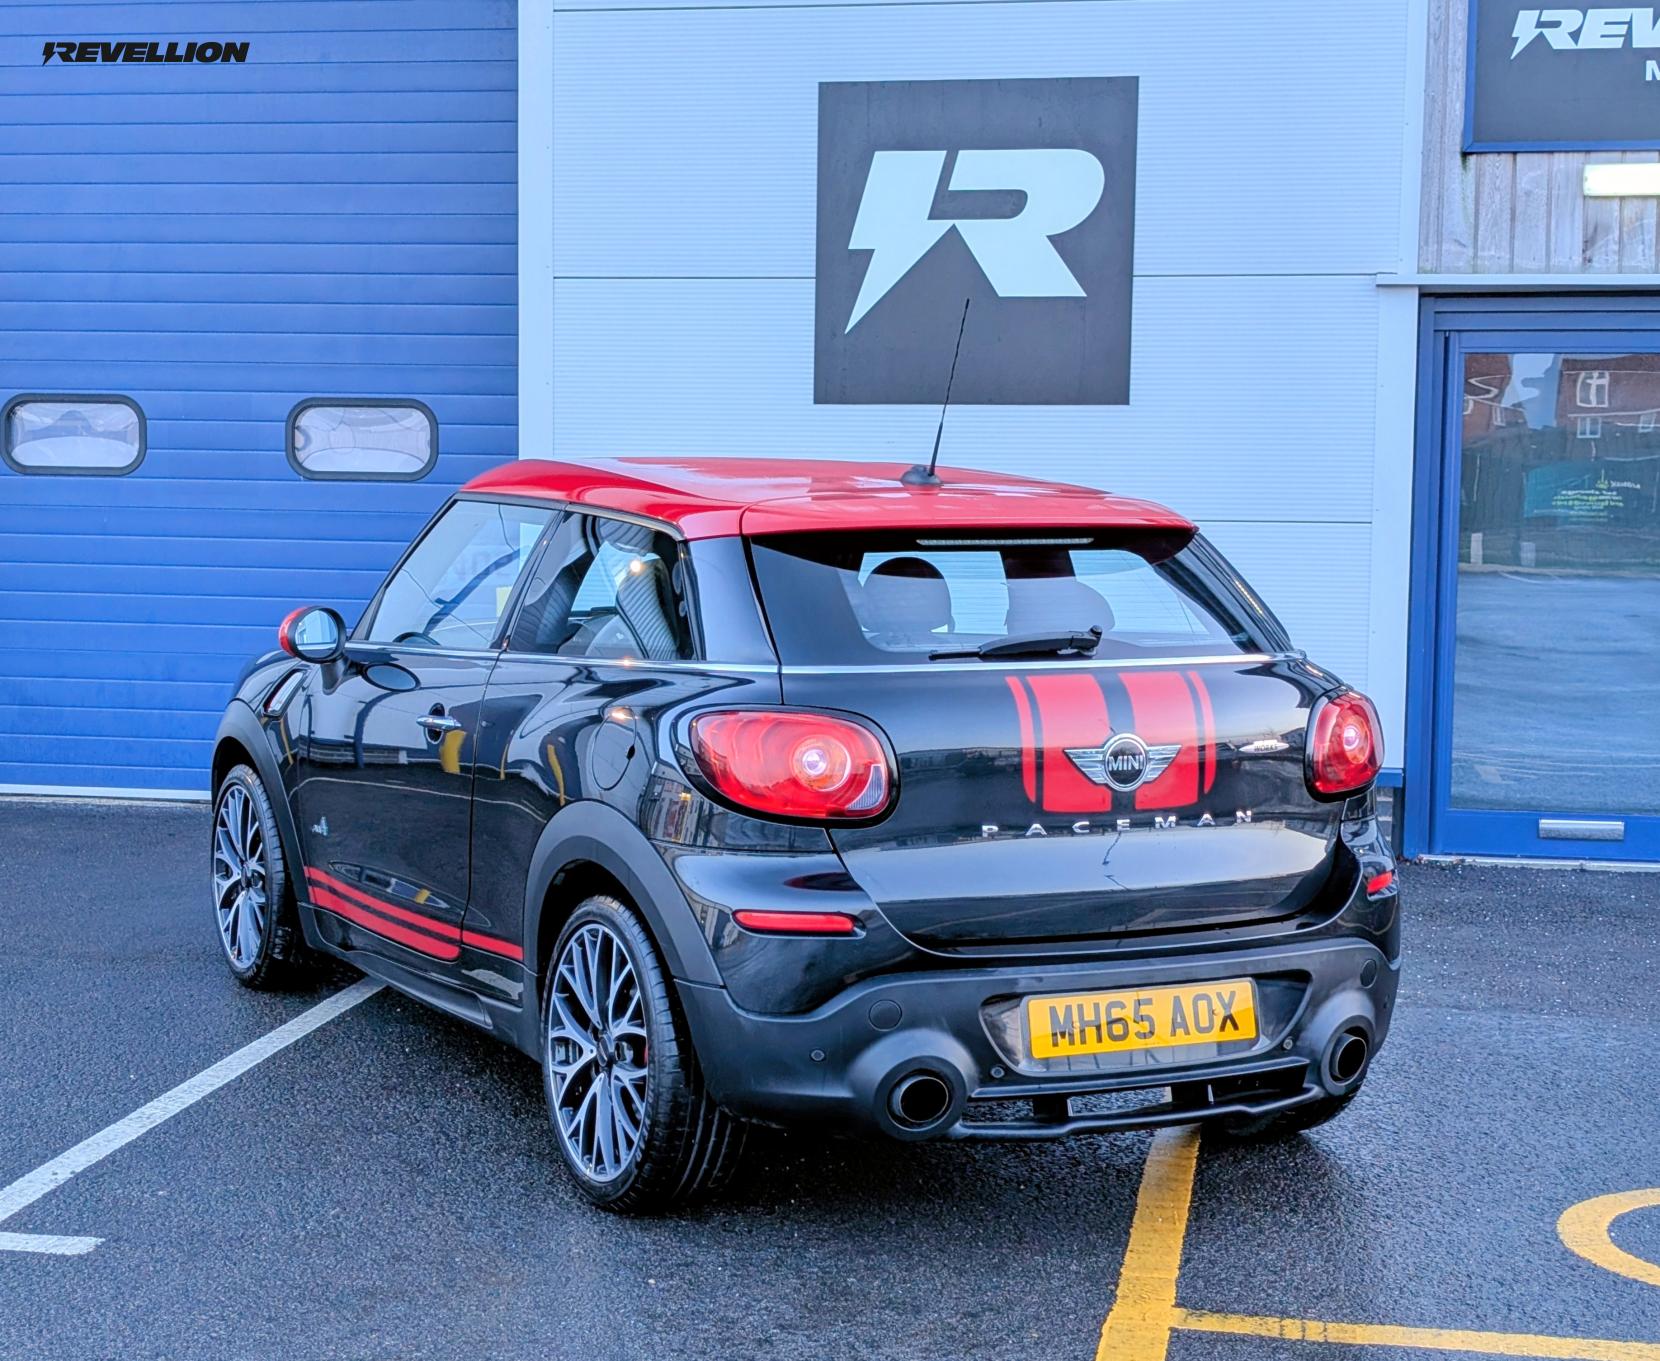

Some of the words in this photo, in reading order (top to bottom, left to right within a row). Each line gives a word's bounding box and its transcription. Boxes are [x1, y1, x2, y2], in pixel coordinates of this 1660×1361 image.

[1108, 755, 1144, 771] MINI
[981, 810, 1252, 838] PACEMAN
[1049, 998, 1155, 1047] MH65
[1170, 990, 1239, 1037] AOX
